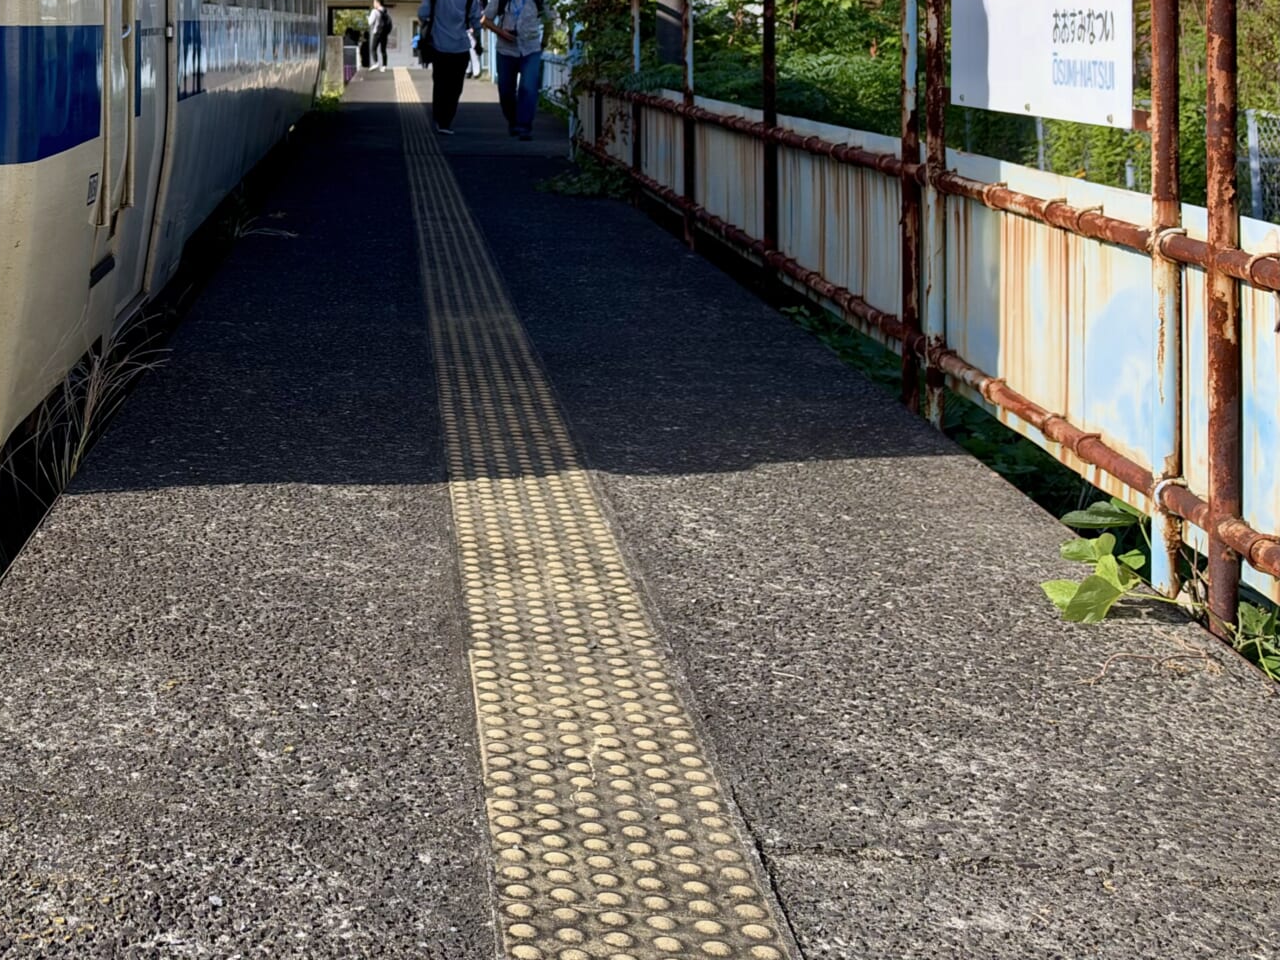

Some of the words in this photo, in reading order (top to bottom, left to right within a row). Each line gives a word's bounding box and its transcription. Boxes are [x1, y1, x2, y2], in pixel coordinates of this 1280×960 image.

[1052, 8, 1115, 44] おおすみなつい
